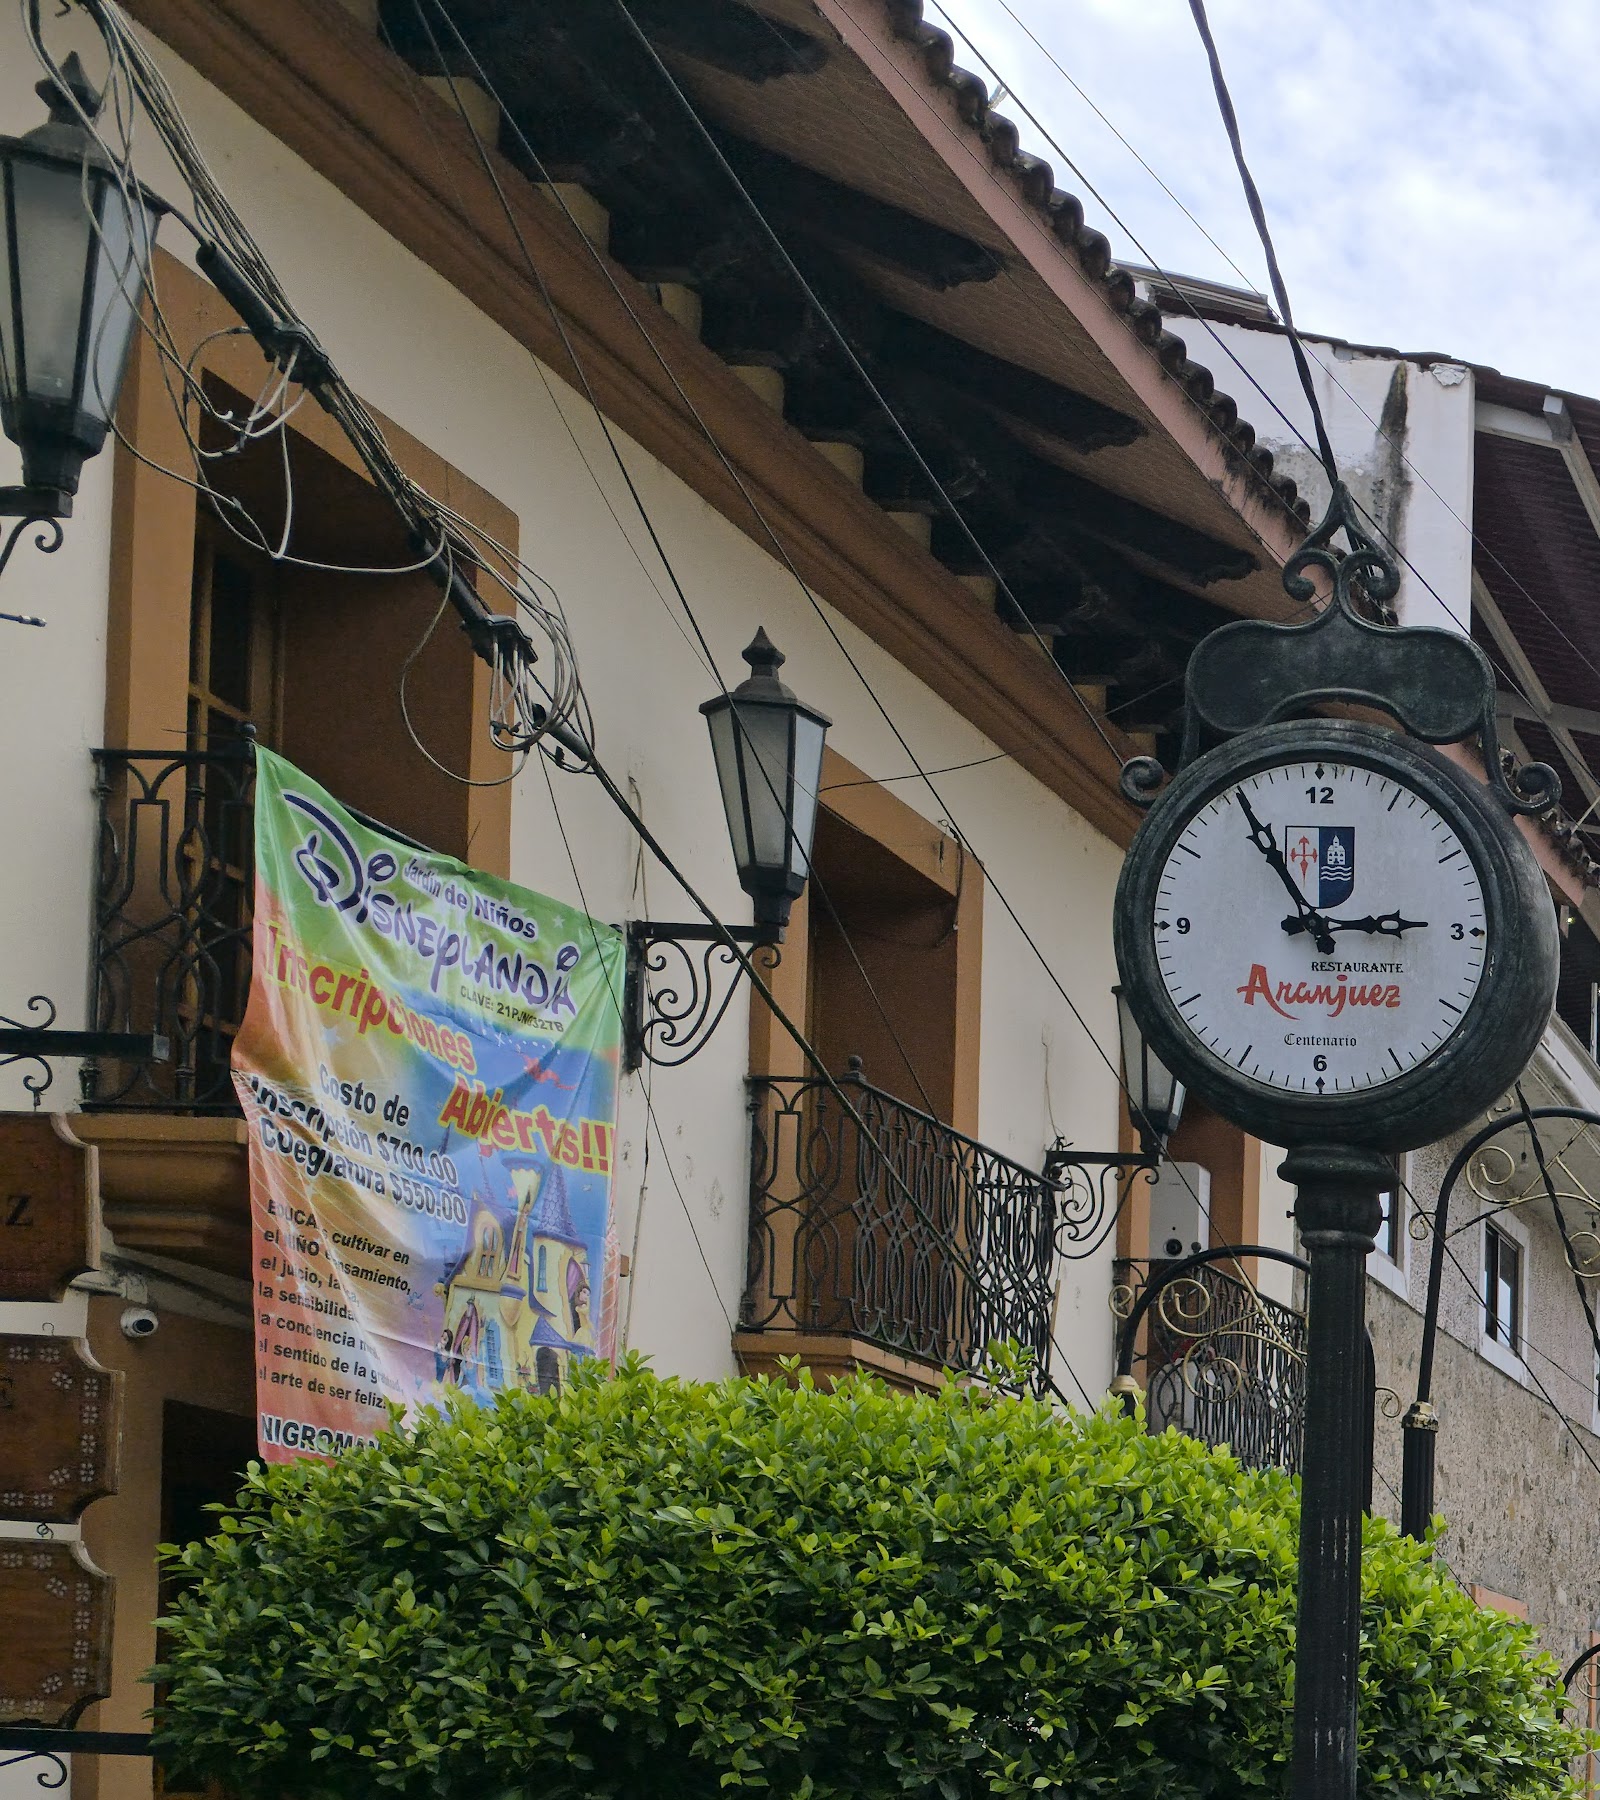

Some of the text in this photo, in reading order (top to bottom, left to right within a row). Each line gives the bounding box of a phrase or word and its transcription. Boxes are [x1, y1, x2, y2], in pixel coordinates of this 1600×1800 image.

[1305, 787, 1334, 805] 12
[445, 884, 468, 910] de
[474, 897, 536, 940] Niños
[1177, 918, 1191, 934] 9
[1450, 924, 1464, 940] 3
[1311, 961, 1404, 973] RESTAURANTE
[266, 922, 478, 1076] Inscripciones
[1237, 963, 1400, 1020] Aranjuez
[1284, 1033, 1357, 1048] Centenario
[1313, 1055, 1327, 1072] 6
[319, 1063, 410, 1127] Costo de
[376, 1131, 459, 1188] $700.00
[390, 1172, 468, 1226] $550.00
[263, 1228, 279, 1246] el
[332, 1231, 391, 1260] cultivar
[393, 1248, 410, 1265] en
[260, 1255, 277, 1272] el
[258, 1281, 273, 1299] la
[279, 1288, 360, 1322] sensibilida
[276, 1317, 356, 1348] conciencia
[273, 1343, 328, 1368] sentido
[331, 1357, 350, 1374] de
[353, 1361, 368, 1378] la
[271, 1370, 304, 1389] arte
[307, 1375, 326, 1394] de
[329, 1384, 352, 1400] ser
